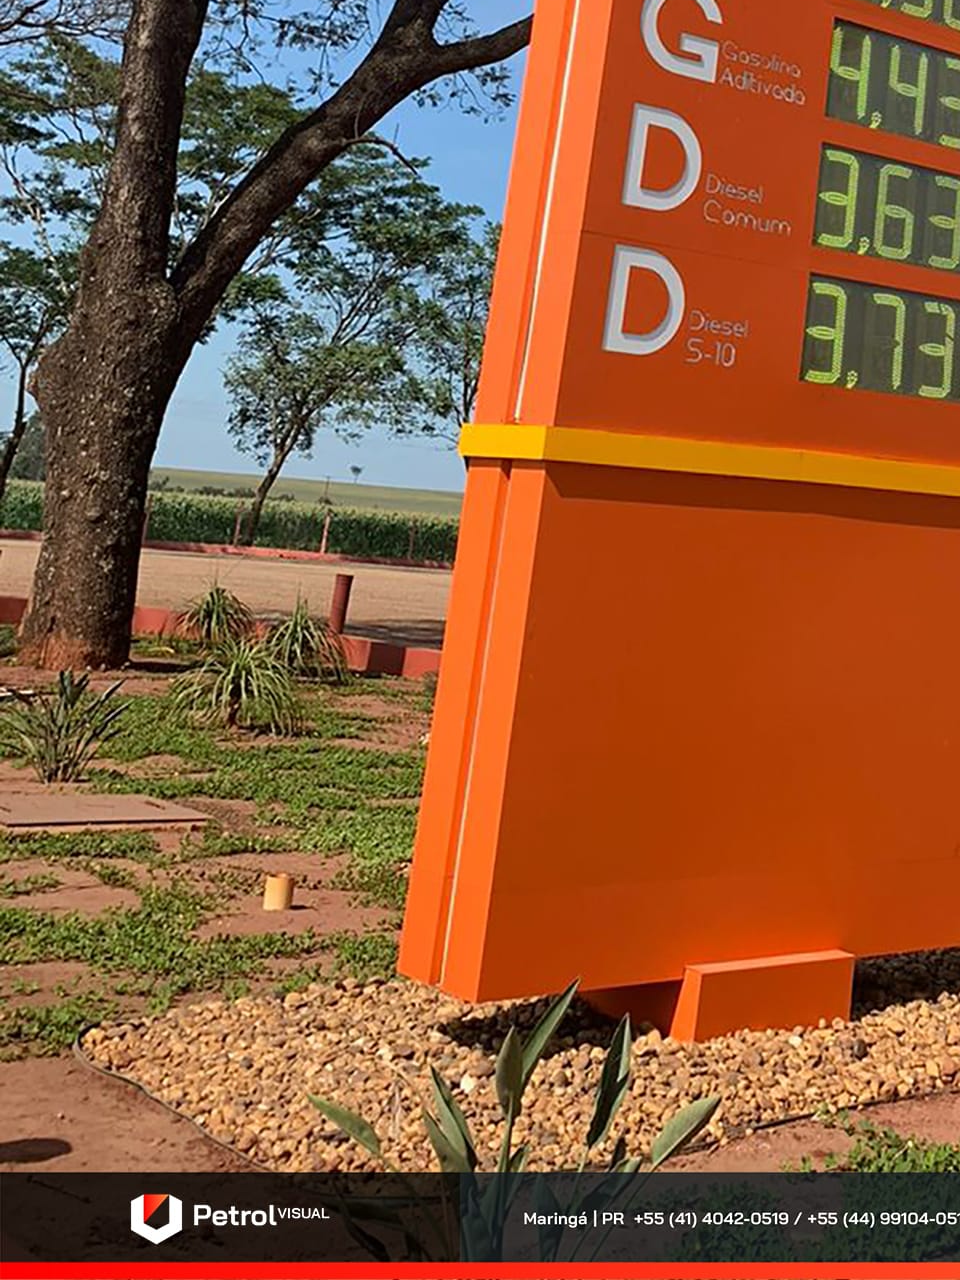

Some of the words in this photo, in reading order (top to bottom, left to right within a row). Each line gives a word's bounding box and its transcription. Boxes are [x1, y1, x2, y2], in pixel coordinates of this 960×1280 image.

[720, 40, 802, 78] Gasolina
[718, 67, 806, 106] Aditivado
[622, 102, 702, 211] D
[705, 173, 764, 204] Diesel
[703, 199, 792, 236] Comum
[602, 243, 686, 356] D
[688, 309, 749, 338] Diesel
[685, 337, 737, 368] S-10
